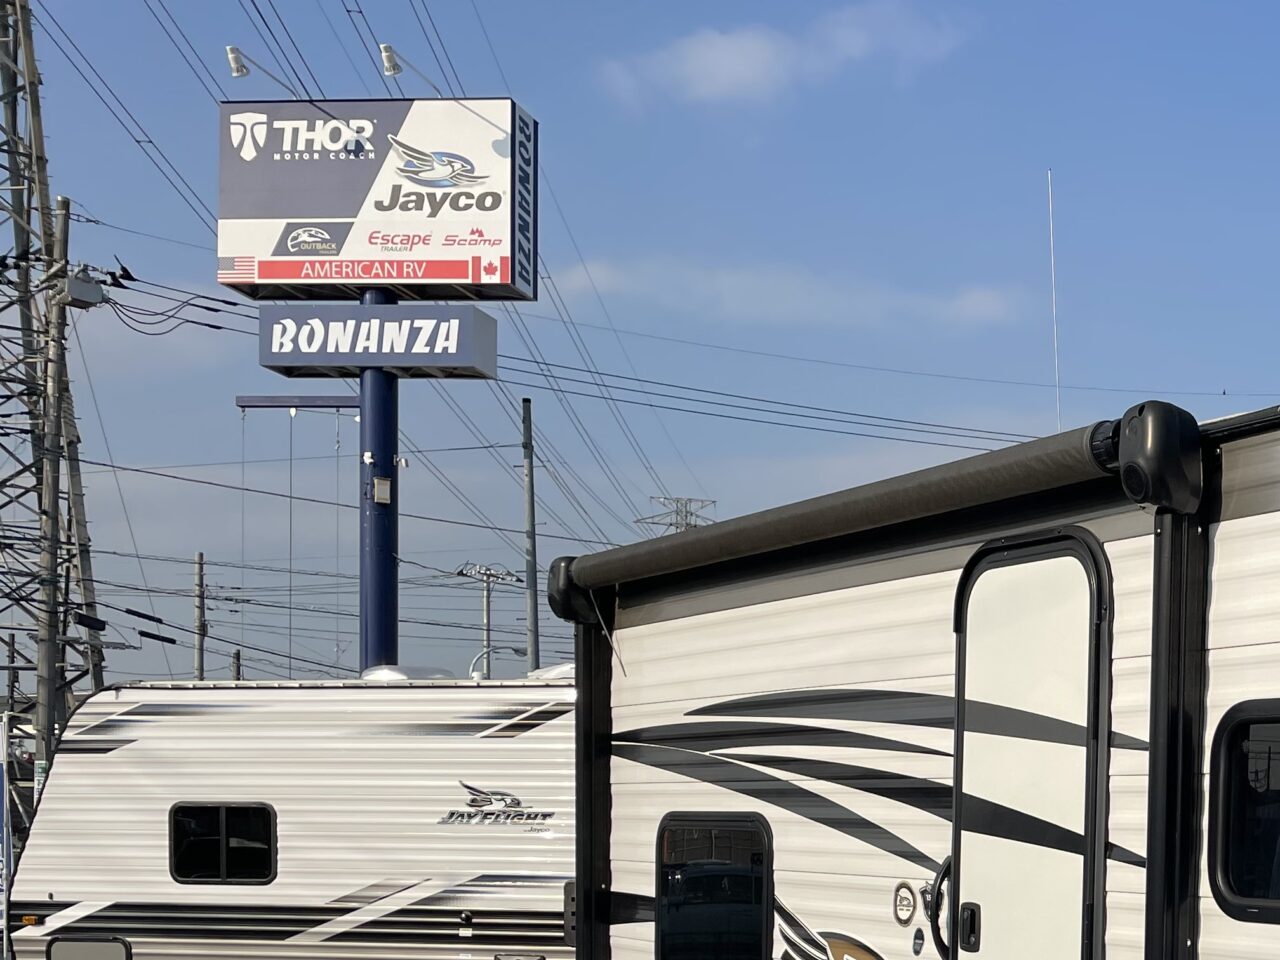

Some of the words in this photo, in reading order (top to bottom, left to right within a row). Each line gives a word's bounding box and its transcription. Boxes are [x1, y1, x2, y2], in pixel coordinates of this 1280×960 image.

[273, 119, 374, 151] THOR
[274, 152, 319, 160] MOTOR
[330, 152, 375, 160] COACH
[374, 184, 503, 218] Jayco
[518, 114, 532, 288] BONANZA
[300, 242, 337, 250] OUTBACK
[368, 231, 432, 251] Escape
[442, 235, 503, 247] Scamp
[301, 261, 398, 278] AMERICAN
[403, 261, 427, 278] RV
[271, 318, 460, 354] BONANZA
[437, 810, 480, 825] JAY
[475, 811, 556, 825] FLIGHT
